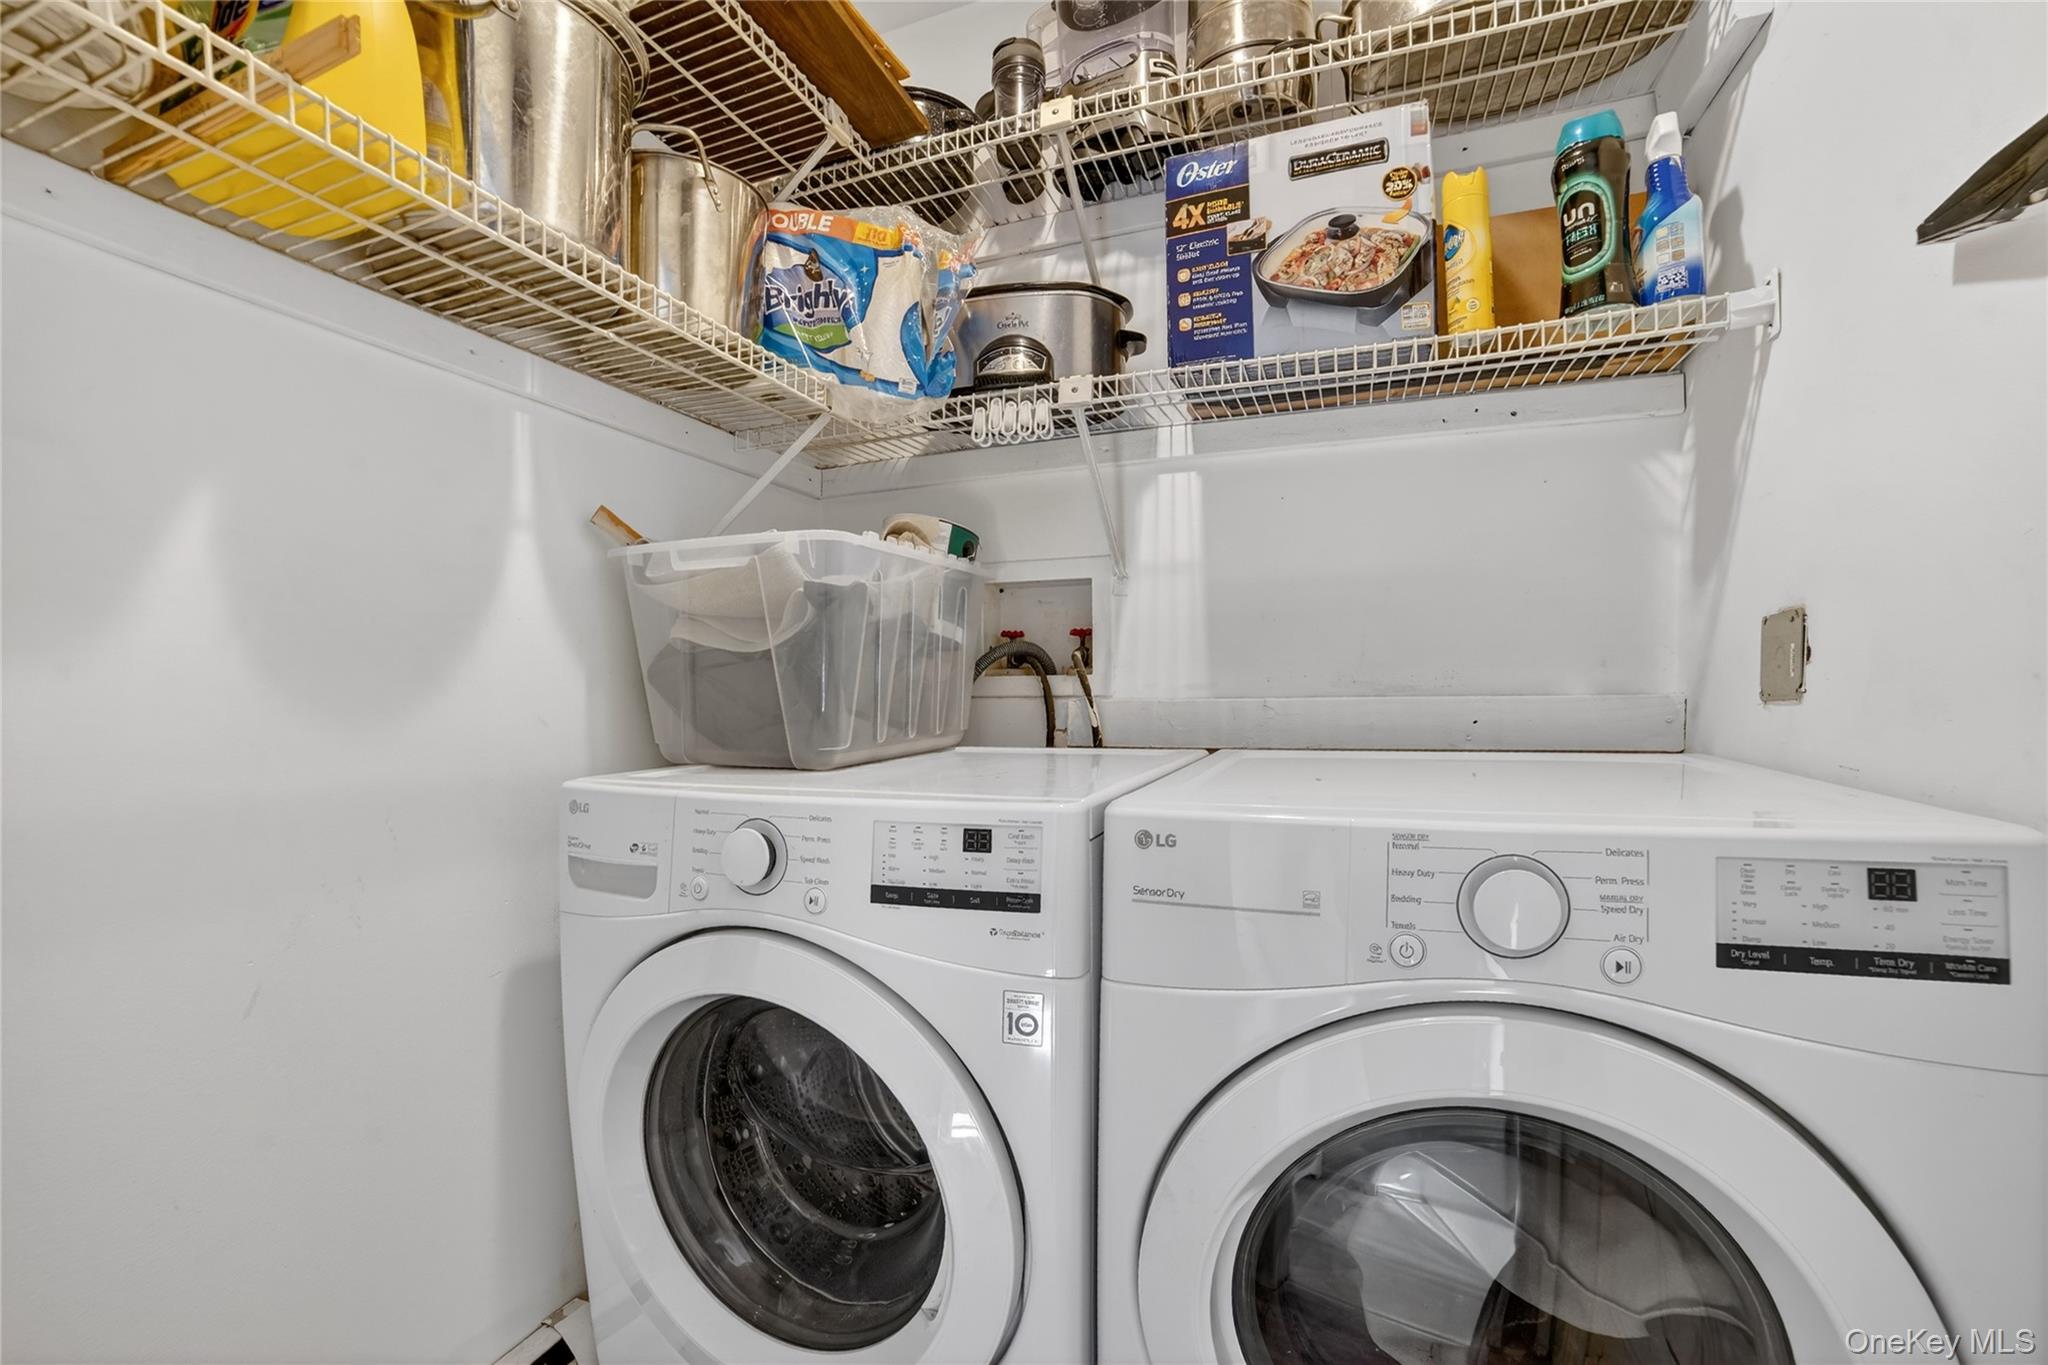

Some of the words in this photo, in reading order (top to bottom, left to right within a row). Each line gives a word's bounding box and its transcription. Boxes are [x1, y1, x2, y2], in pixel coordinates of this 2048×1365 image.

[1176, 159, 1239, 188] Oster
[1172, 202, 1206, 229] 4X
[771, 212, 834, 232] OUBLE
[1156, 834, 1177, 848] LG
[1605, 848, 1645, 857] Delicates
[1391, 868, 1415, 878] Heavy
[1417, 869, 1435, 879] Duty
[1621, 877, 1645, 886] Press
[1391, 894, 1422, 905] Bedding
[1601, 905, 1627, 914] Speed
[1629, 905, 1644, 917] Dry
[1614, 934, 1627, 942] Air
[1629, 934, 1645, 944] Dry
[1731, 949, 1745, 958] Dry
[1748, 950, 1770, 959] Level
[1897, 958, 1915, 970] Dry
[1007, 1012, 1039, 1037] 10
